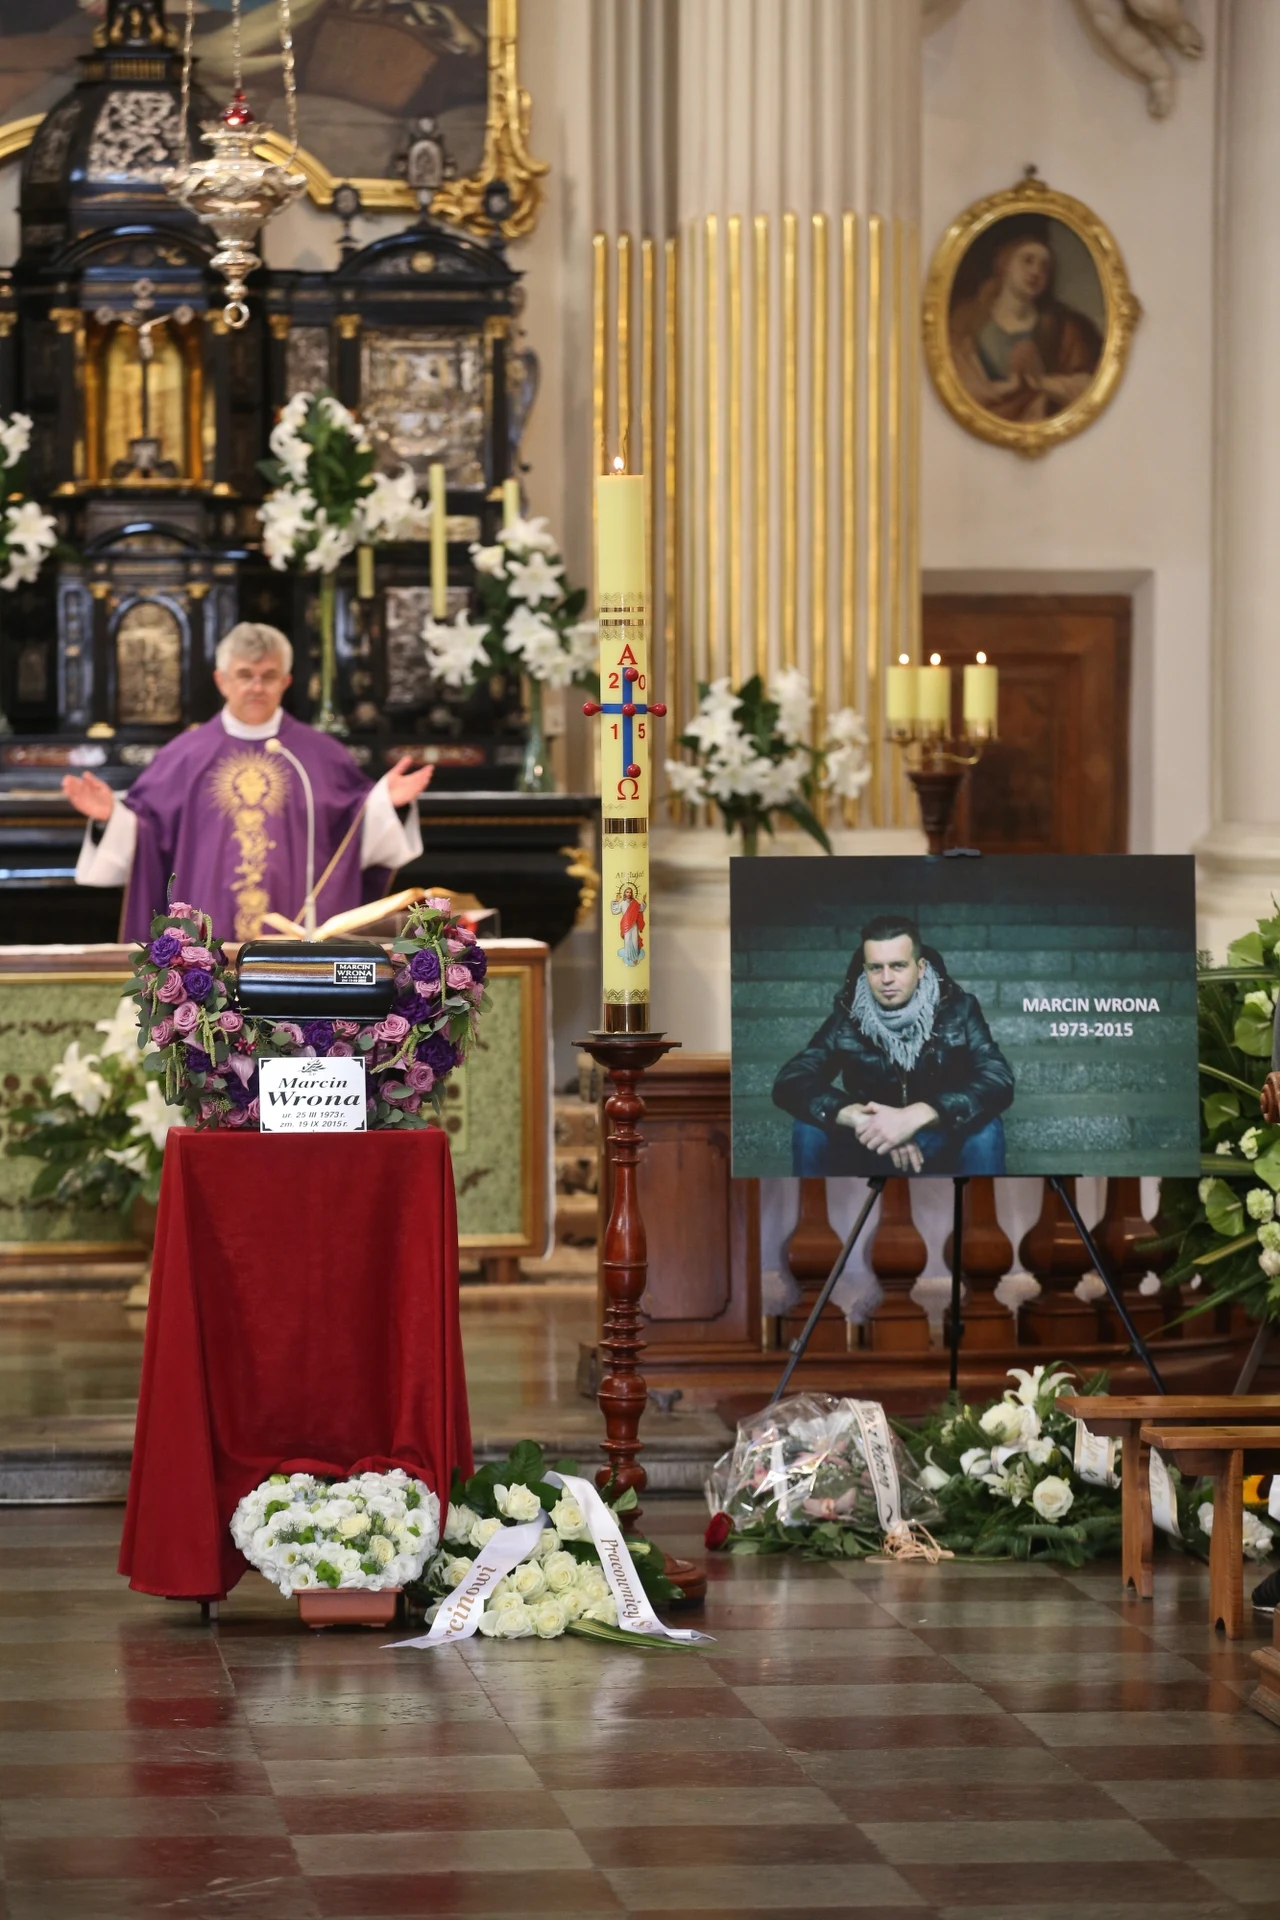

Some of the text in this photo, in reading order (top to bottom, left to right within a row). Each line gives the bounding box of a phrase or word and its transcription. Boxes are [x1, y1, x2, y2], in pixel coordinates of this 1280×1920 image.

[616, 643, 639, 666] A
[608, 672, 647, 690] 2 0
[610, 723, 646, 740] 1 5
[617, 778, 640, 800] Ω
[1022, 998, 1161, 1012] MARCIN WRONA
[1049, 1022, 1134, 1037] 1973-2015
[278, 1076, 348, 1089] Marcin
[267, 1091, 361, 1107] Wrona
[599, 1537, 642, 1619] Pracownicy
